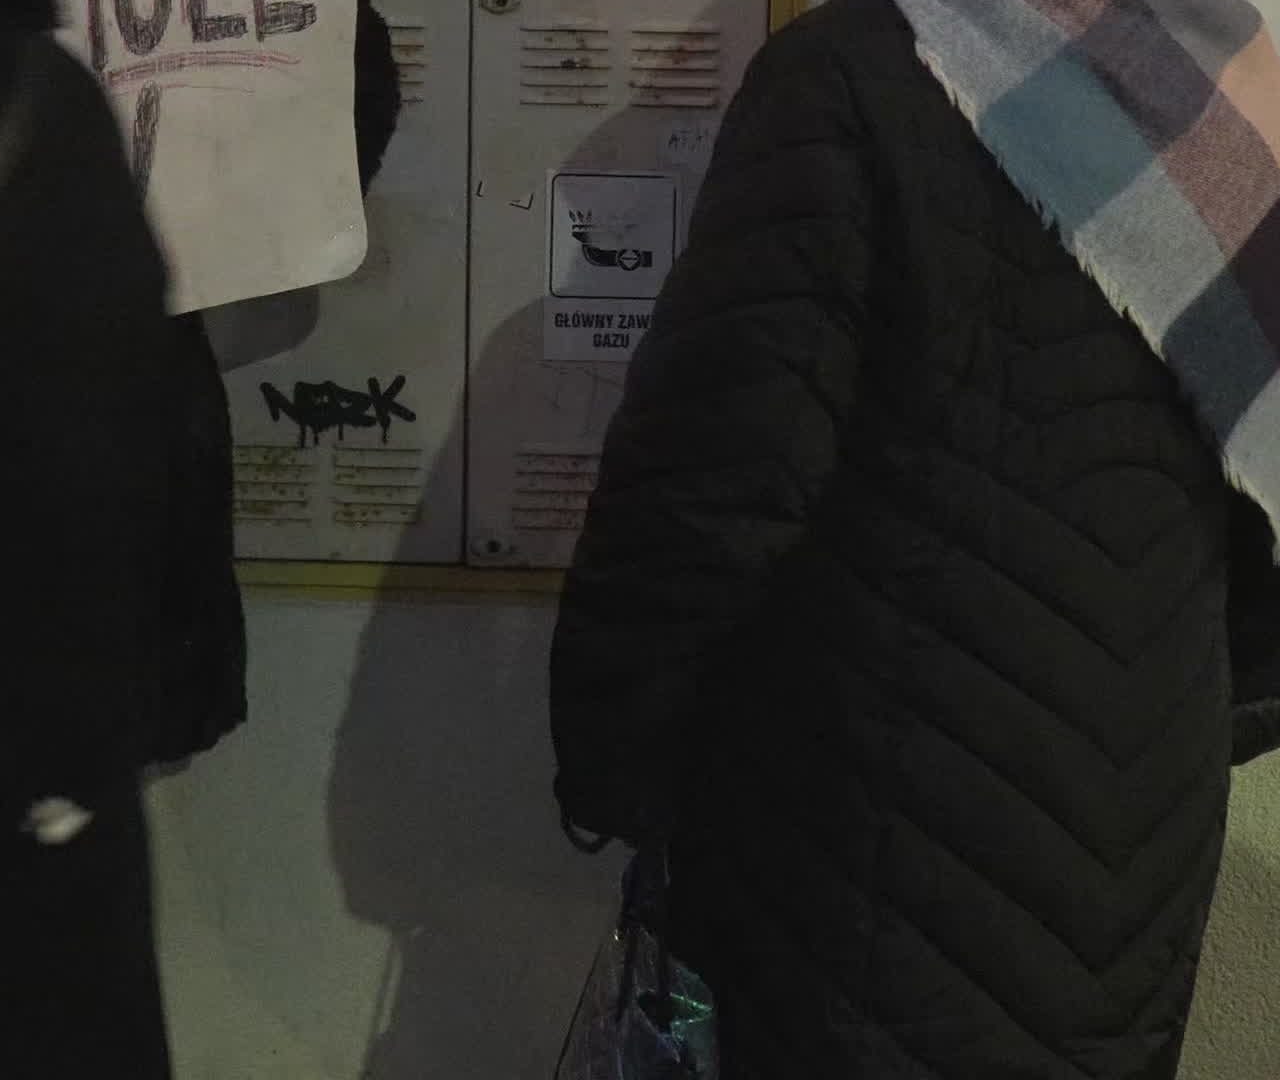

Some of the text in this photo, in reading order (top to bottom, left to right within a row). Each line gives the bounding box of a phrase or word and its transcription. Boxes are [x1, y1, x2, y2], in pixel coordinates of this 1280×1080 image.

[554, 309, 657, 330] GŁÓWNY ZAW
[592, 332, 630, 349] GAZU
